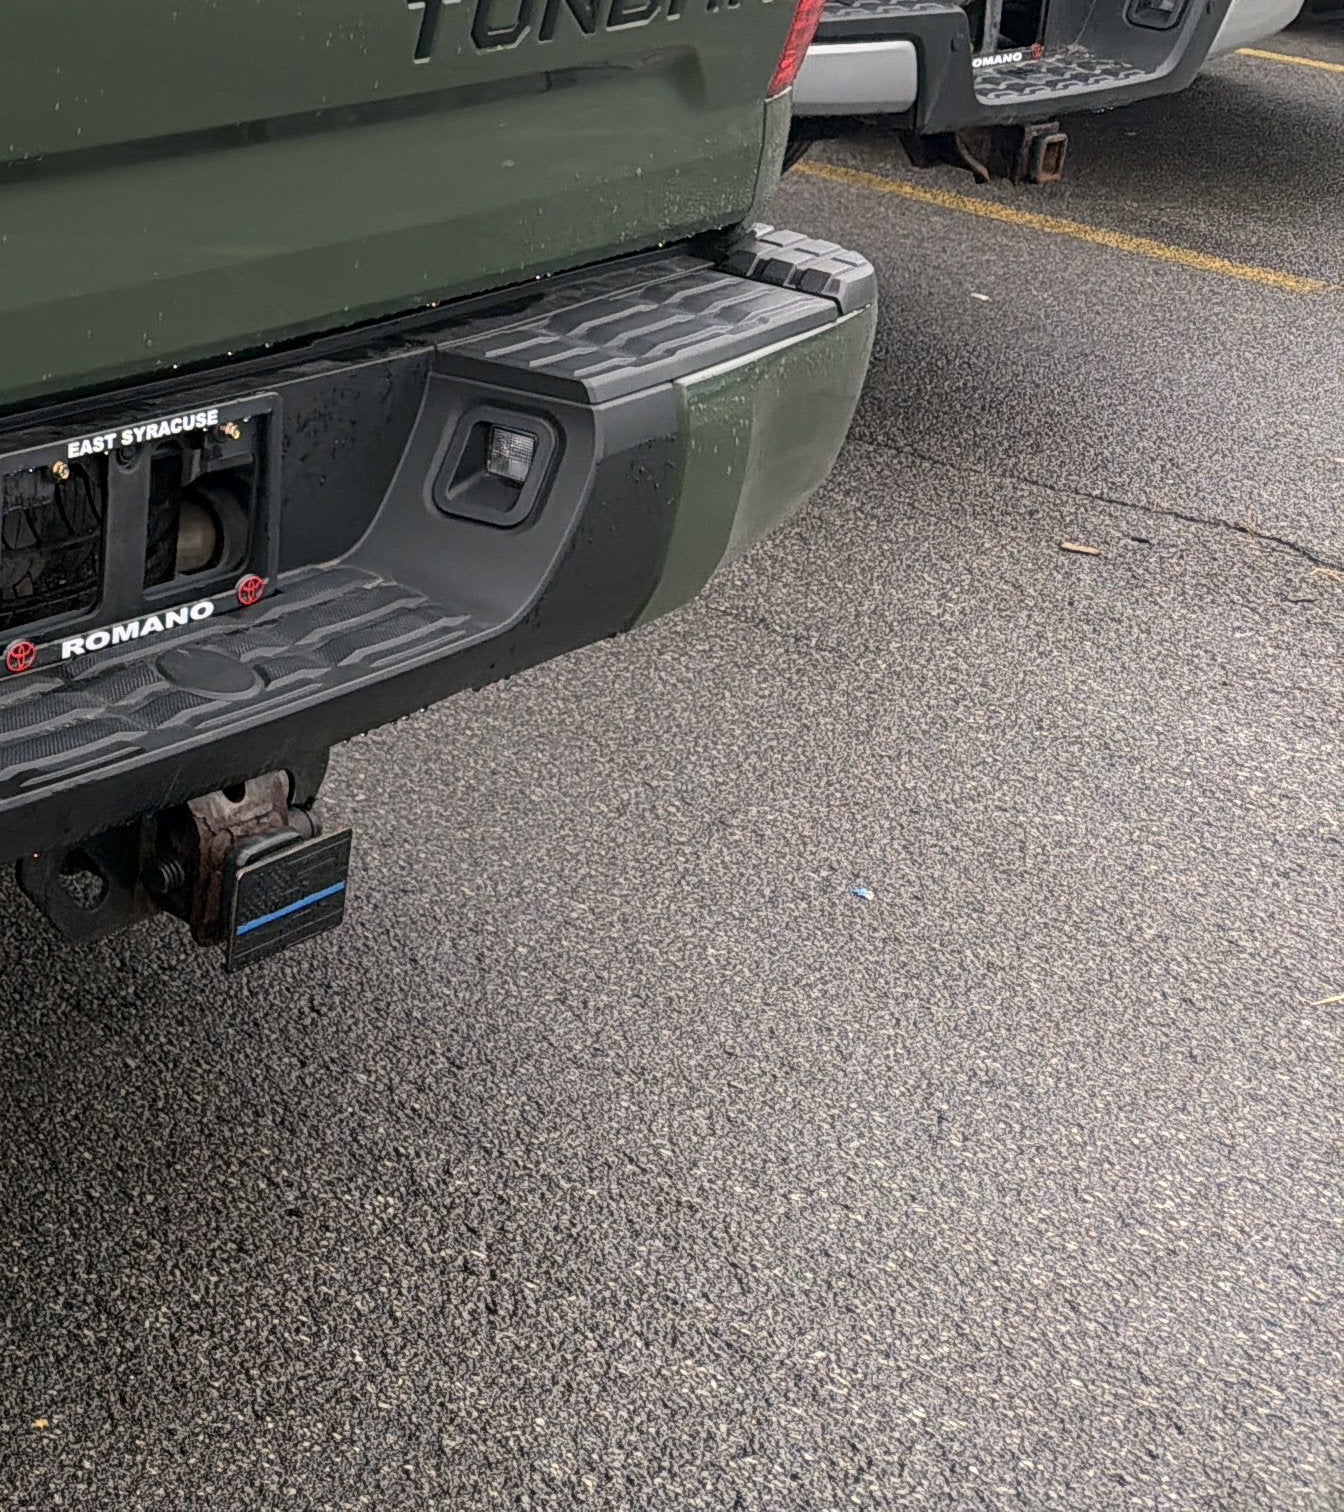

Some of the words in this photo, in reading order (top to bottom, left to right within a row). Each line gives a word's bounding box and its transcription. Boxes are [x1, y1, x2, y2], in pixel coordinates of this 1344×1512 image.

[972, 51, 1023, 68] OMANO
[67, 435, 118, 459] EAST
[120, 409, 219, 447] SYRACUSE
[60, 600, 216, 659] ROMANO
